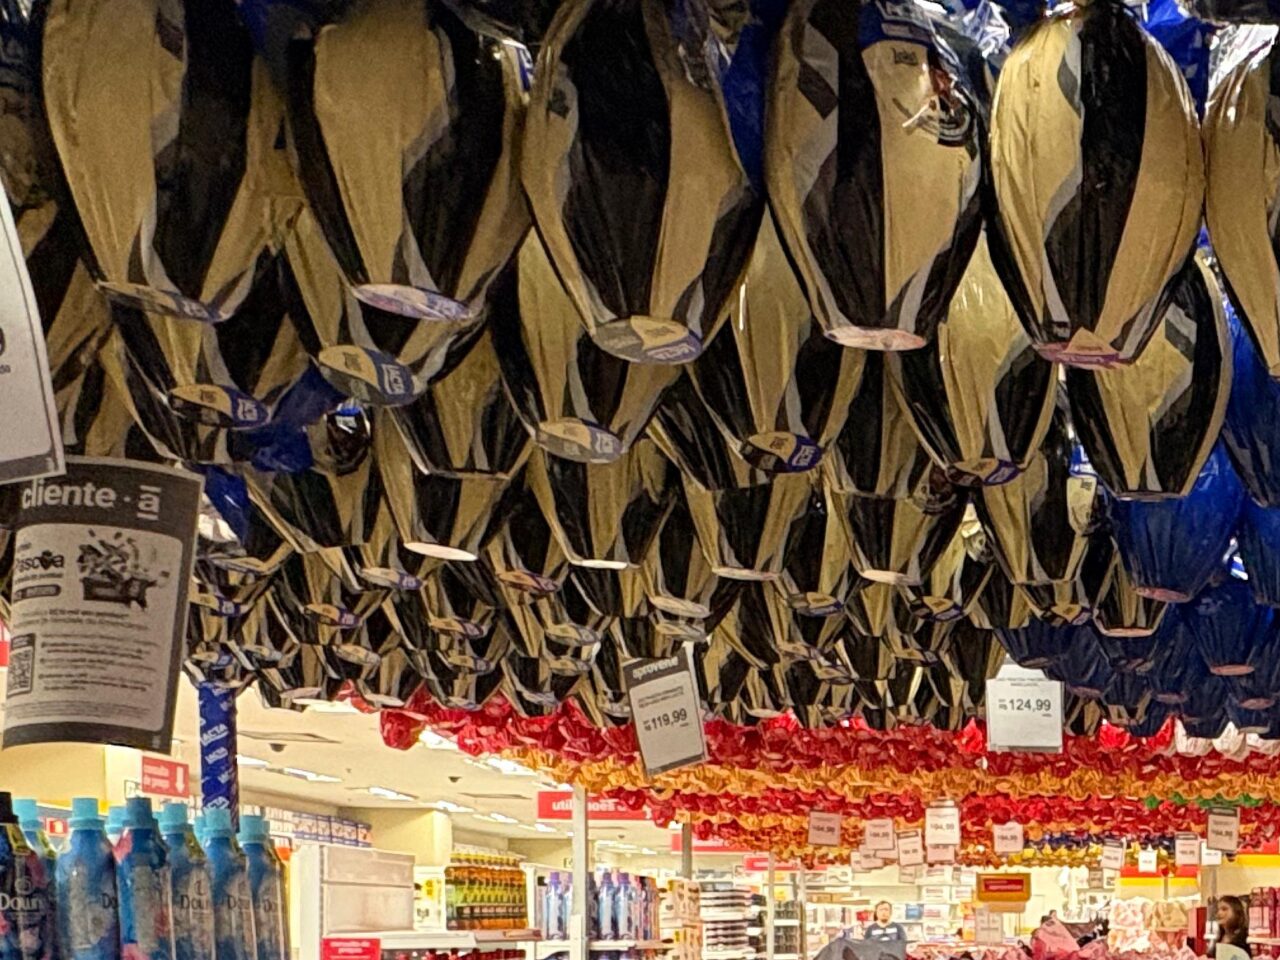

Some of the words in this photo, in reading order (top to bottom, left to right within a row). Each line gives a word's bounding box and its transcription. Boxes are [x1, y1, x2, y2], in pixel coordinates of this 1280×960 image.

[22, 478, 116, 510] cliente
[1008, 699, 1051, 712] 124,99
[651, 708, 687, 729] 119,99
